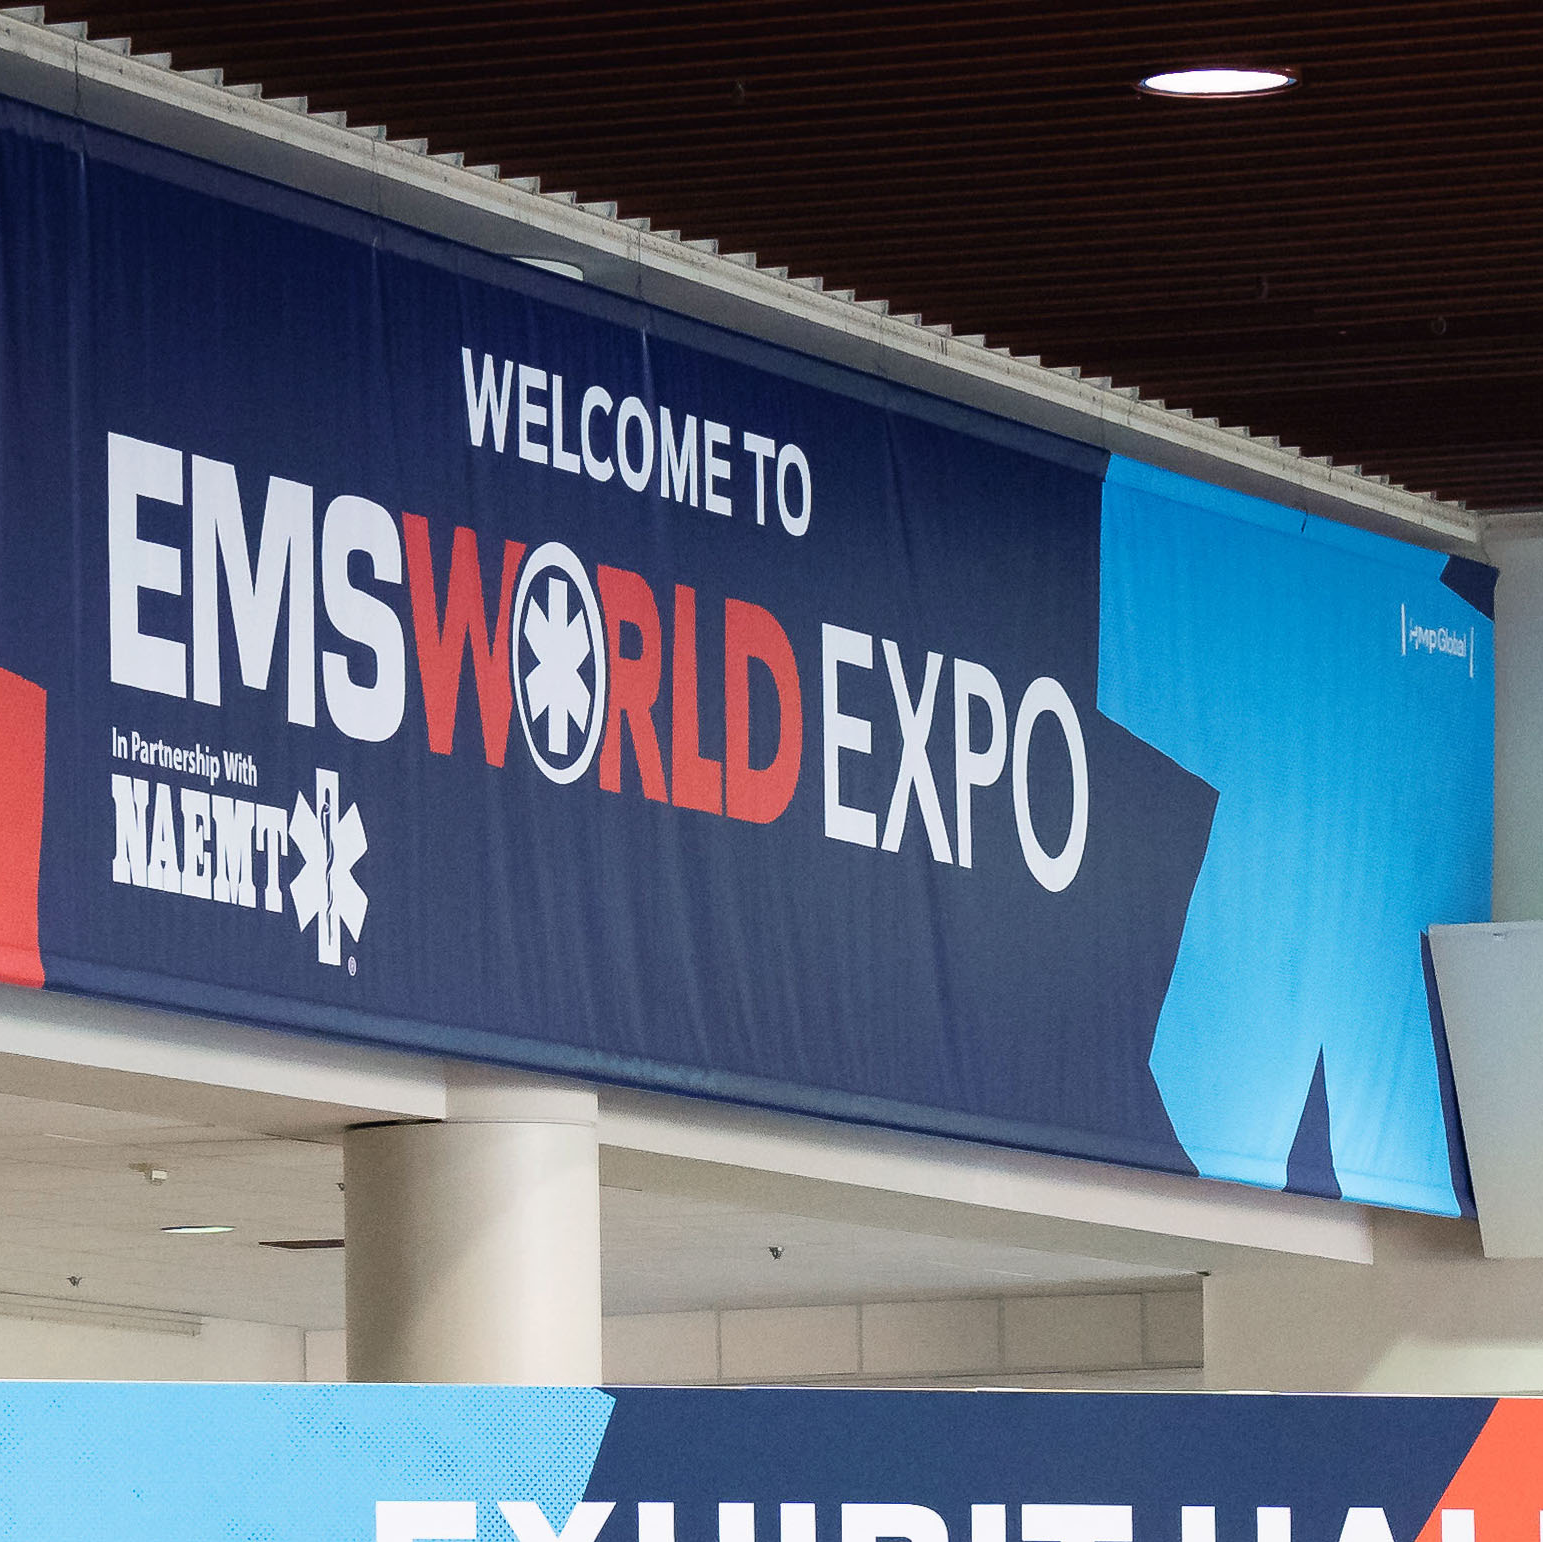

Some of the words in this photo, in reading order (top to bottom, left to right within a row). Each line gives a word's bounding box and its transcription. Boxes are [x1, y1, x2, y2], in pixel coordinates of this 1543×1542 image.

[462, 347, 732, 517] WELCOME
[744, 437, 812, 538] TO
[112, 726, 128, 760] In
[132, 731, 220, 786] Partnership
[223, 750, 258, 787] With
[821, 622, 1089, 893] EXPO
[111, 773, 289, 914] NAEMT
